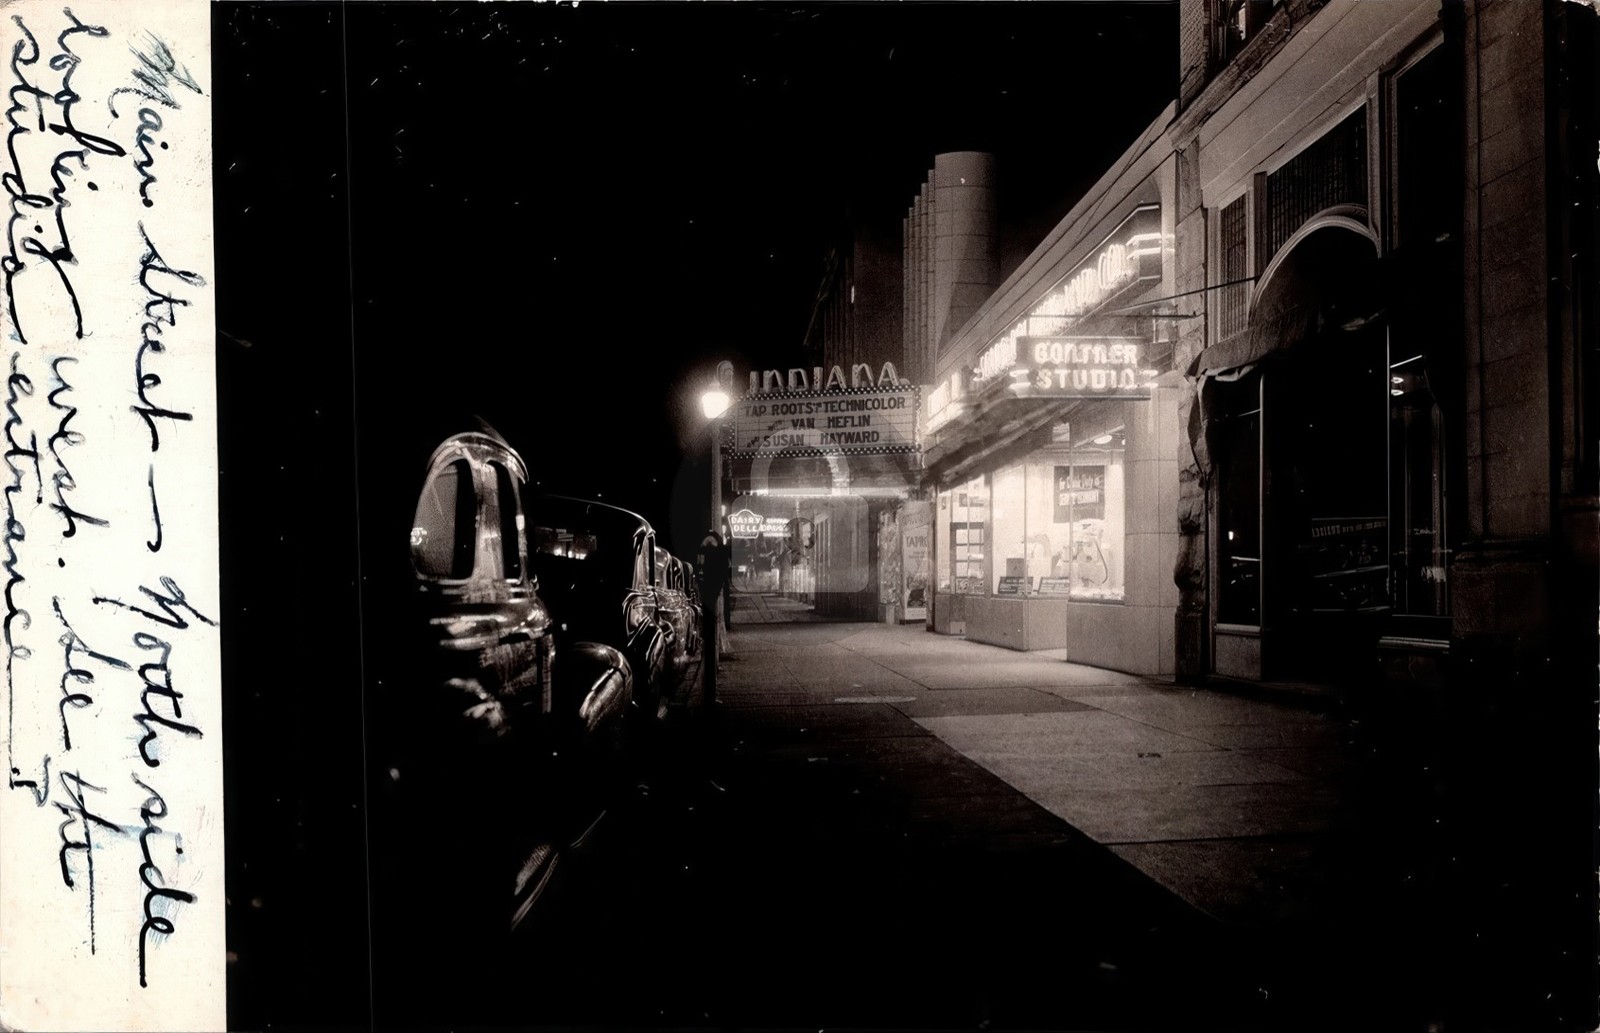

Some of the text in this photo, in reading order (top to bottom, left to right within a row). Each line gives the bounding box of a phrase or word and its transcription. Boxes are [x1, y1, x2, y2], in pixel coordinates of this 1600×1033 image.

[108, 28, 206, 208] Main
[1, 14, 54, 345] studio
[22, 7, 126, 340] looking
[130, 221, 206, 453] Street
[749, 361, 899, 395] INDIANA
[1036, 368, 1138, 391] STUDIO
[744, 404, 767, 417] TAP
[772, 402, 813, 416] ROOTS
[824, 396, 906, 413] TECHNICOLOR
[763, 433, 805, 448] SUSAN
[820, 430, 880, 445] HAYWARD
[791, 417, 815, 431] VAN
[827, 414, 871, 429] HEFLIN
[731, 516, 761, 524] DAIRY
[733, 524, 758, 532] DELL
[92, 576, 216, 768] North
[51, 768, 128, 955] the
[131, 771, 198, 988] side
